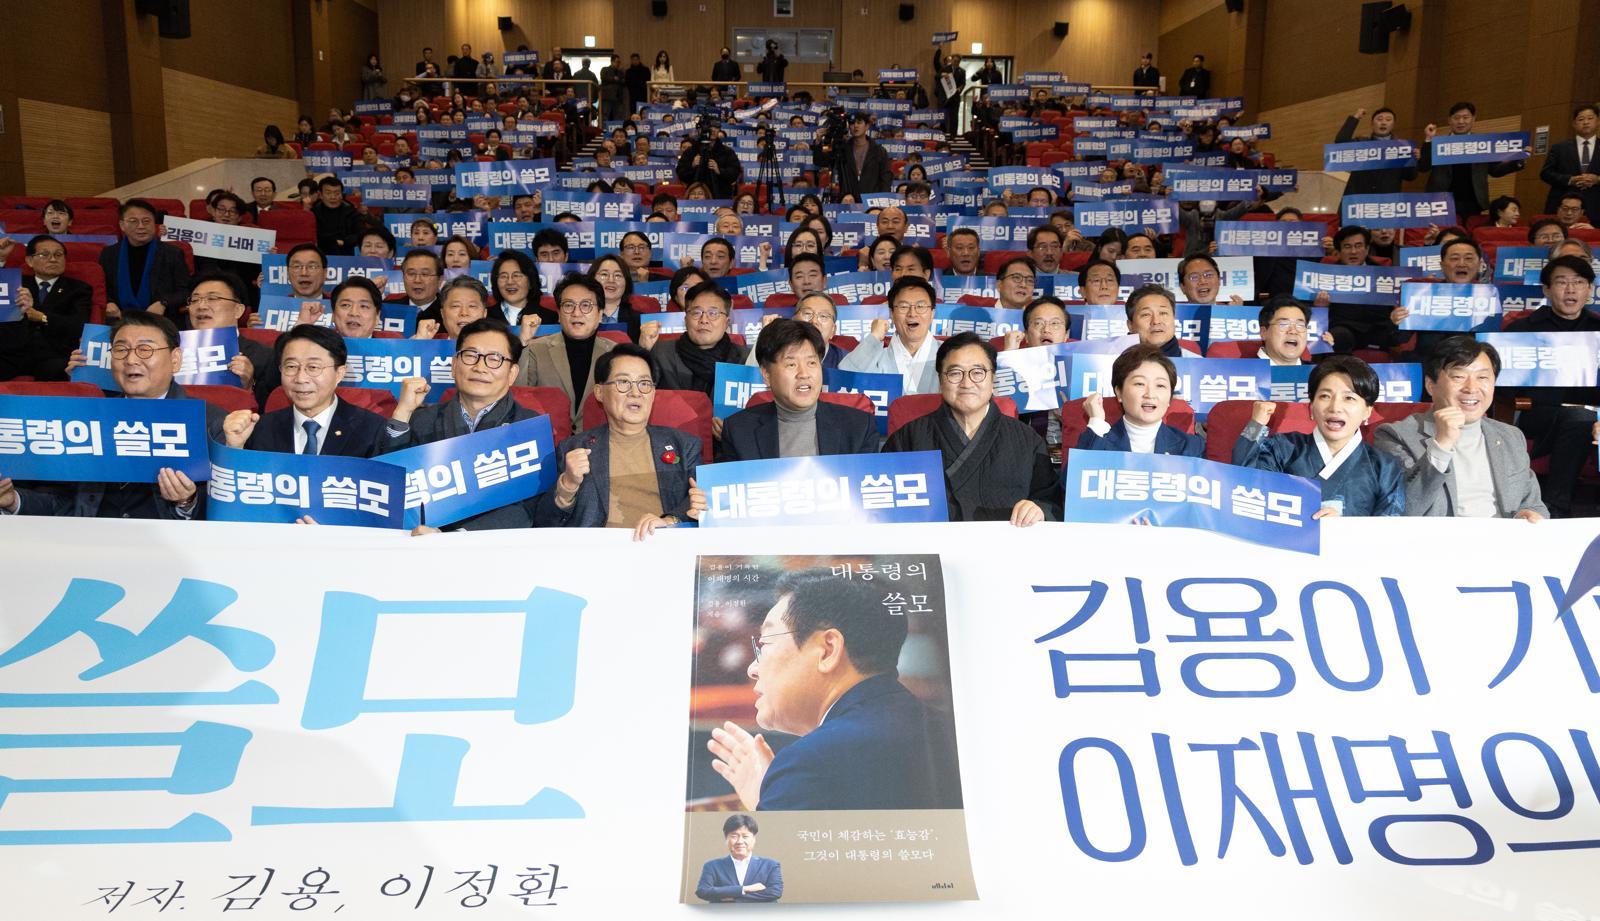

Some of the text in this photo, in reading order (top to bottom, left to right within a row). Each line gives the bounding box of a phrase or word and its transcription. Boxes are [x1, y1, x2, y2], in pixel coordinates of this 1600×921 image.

[1174, 146, 1193, 156] 쓸모
[1329, 145, 1412, 163] 대통령의 쓸모
[1437, 139, 1523, 156] 대통령의 쓸모
[461, 169, 517, 187] 대통령의
[520, 167, 550, 184] 쓸모
[993, 172, 1038, 186] 대통령의
[1041, 174, 1061, 189] 쓸모
[1174, 179, 1224, 192] 대통령의
[1227, 178, 1253, 191] 쓸모
[1272, 174, 1293, 185] 쓸모
[365, 189, 427, 201] 대통령의 쓸모
[545, 200, 635, 219] 대통령의 쓸모
[1080, 206, 1172, 226] 대통령의 쓸모
[1348, 201, 1448, 219] 대통령의 쓸모
[452, 220, 482, 236] 쓸모
[745, 224, 773, 236] 쓸모
[1220, 229, 1319, 246] 대통령의 쓸모
[167, 227, 271, 253] 김용의 꿈 너머 꿈
[564, 231, 595, 249] 쓸모
[1408, 254, 1441, 272] 대통
[1232, 270, 1249, 287] 꿈
[1302, 271, 1370, 294] 대통령의
[738, 281, 792, 303] 대통령
[1408, 294, 1497, 316] 대통령의
[380, 317, 405, 333] 모
[1176, 319, 1201, 340] 모
[430, 355, 456, 384] 쓸
[1200, 374, 1257, 403] 쓸모
[113, 420, 190, 457] 쓸모
[404, 440, 541, 510] 령의 쓸모
[209, 463, 390, 517] 통령의 쓸모
[711, 473, 930, 519] 대통령의 쓸모
[1079, 469, 1303, 528] 대통령의 쓸모
[707, 573, 760, 583] 이재명의 시간
[831, 562, 927, 582] 대통령의
[881, 592, 934, 616] 쓸모
[1030, 575, 1600, 699] 김용이 기
[0, 577, 588, 845] 쓸모
[1057, 728, 1600, 867] 이재명의
[797, 829, 833, 842] 국민이
[837, 829, 886, 842] 체감하는
[803, 849, 935, 862] 그것이 대통령의 쓸모다
[80, 863, 569, 915] 저자. 김용, 이정환
